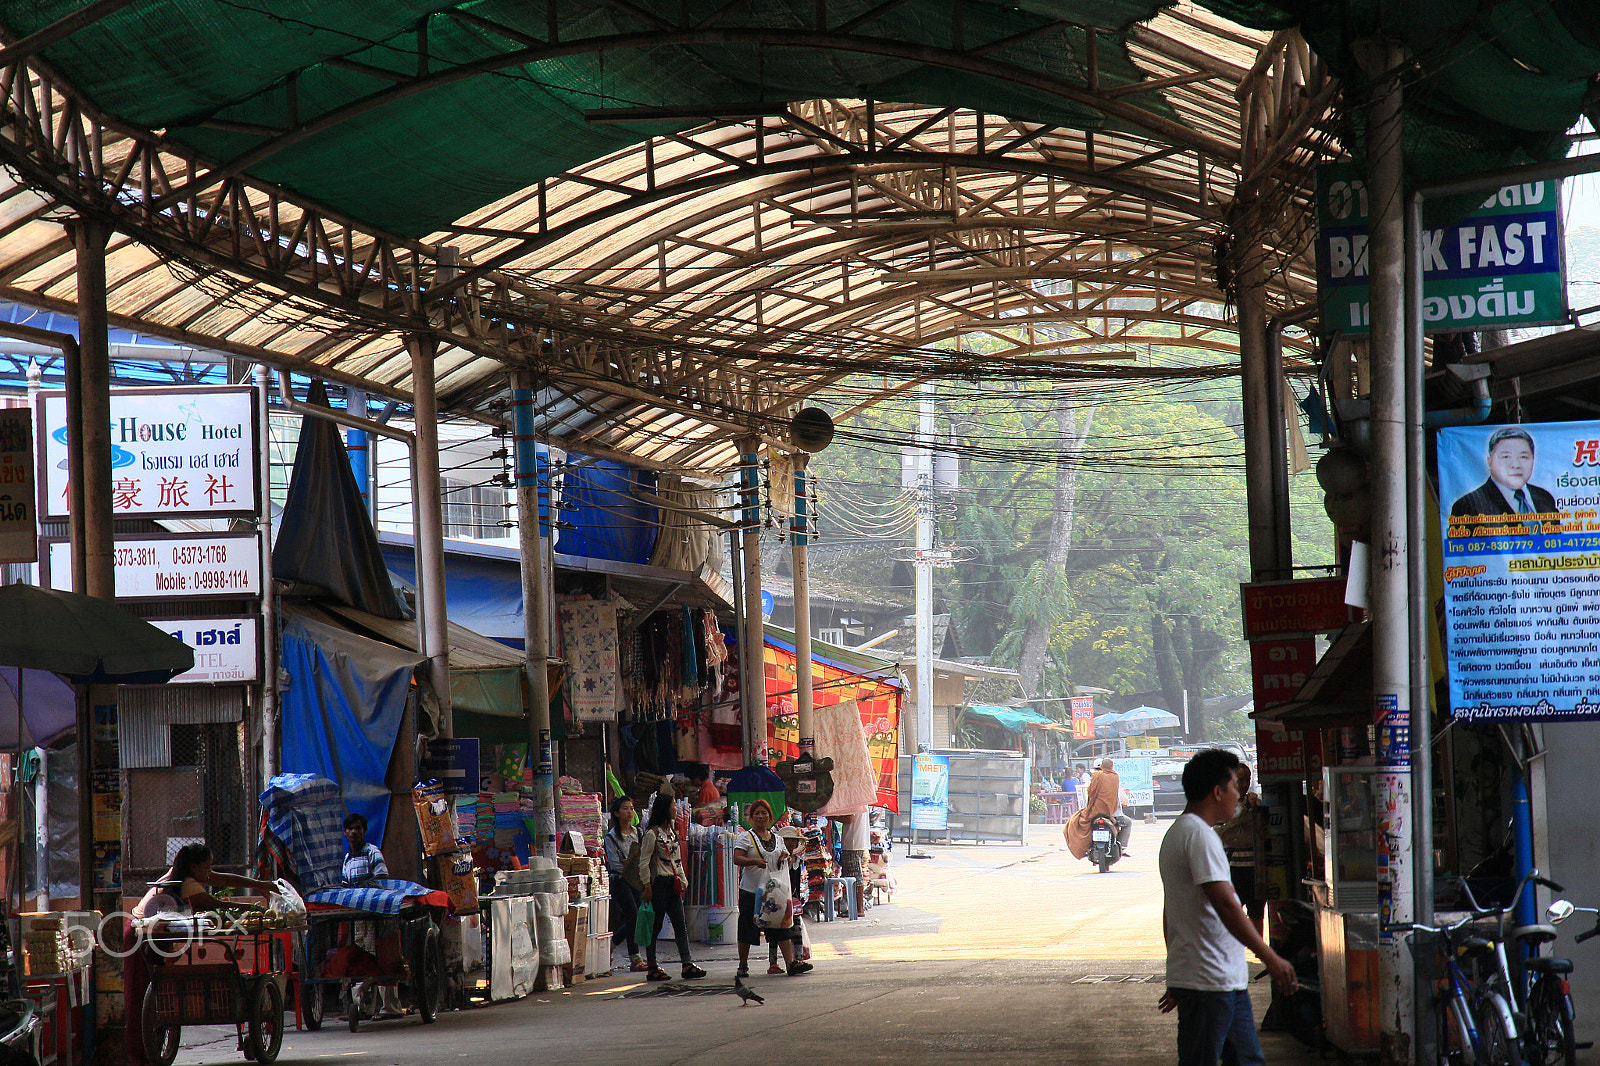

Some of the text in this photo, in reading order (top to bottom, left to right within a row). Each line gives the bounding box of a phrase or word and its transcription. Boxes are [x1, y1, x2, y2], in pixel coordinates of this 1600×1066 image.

[1329, 221, 1546, 278] BRK FAST
[119, 417, 243, 442] House Hotel
[0, 455, 25, 484] ข็ง
[140, 448, 240, 470] โรงแรม เอส เฮาส์
[1556, 472, 1600, 488] เรื่องส
[113, 545, 227, 567] 5373-3811, 0-5373-1768
[1448, 541, 1464, 552] โทร
[1467, 540, 1533, 552] 087-8307779
[155, 572, 186, 591] Mobile
[194, 570, 248, 590] 0-9998-1114
[196, 623, 242, 646] เฮาส์
[197, 653, 227, 668] TEL
[213, 665, 245, 679] ทางขึ้น
